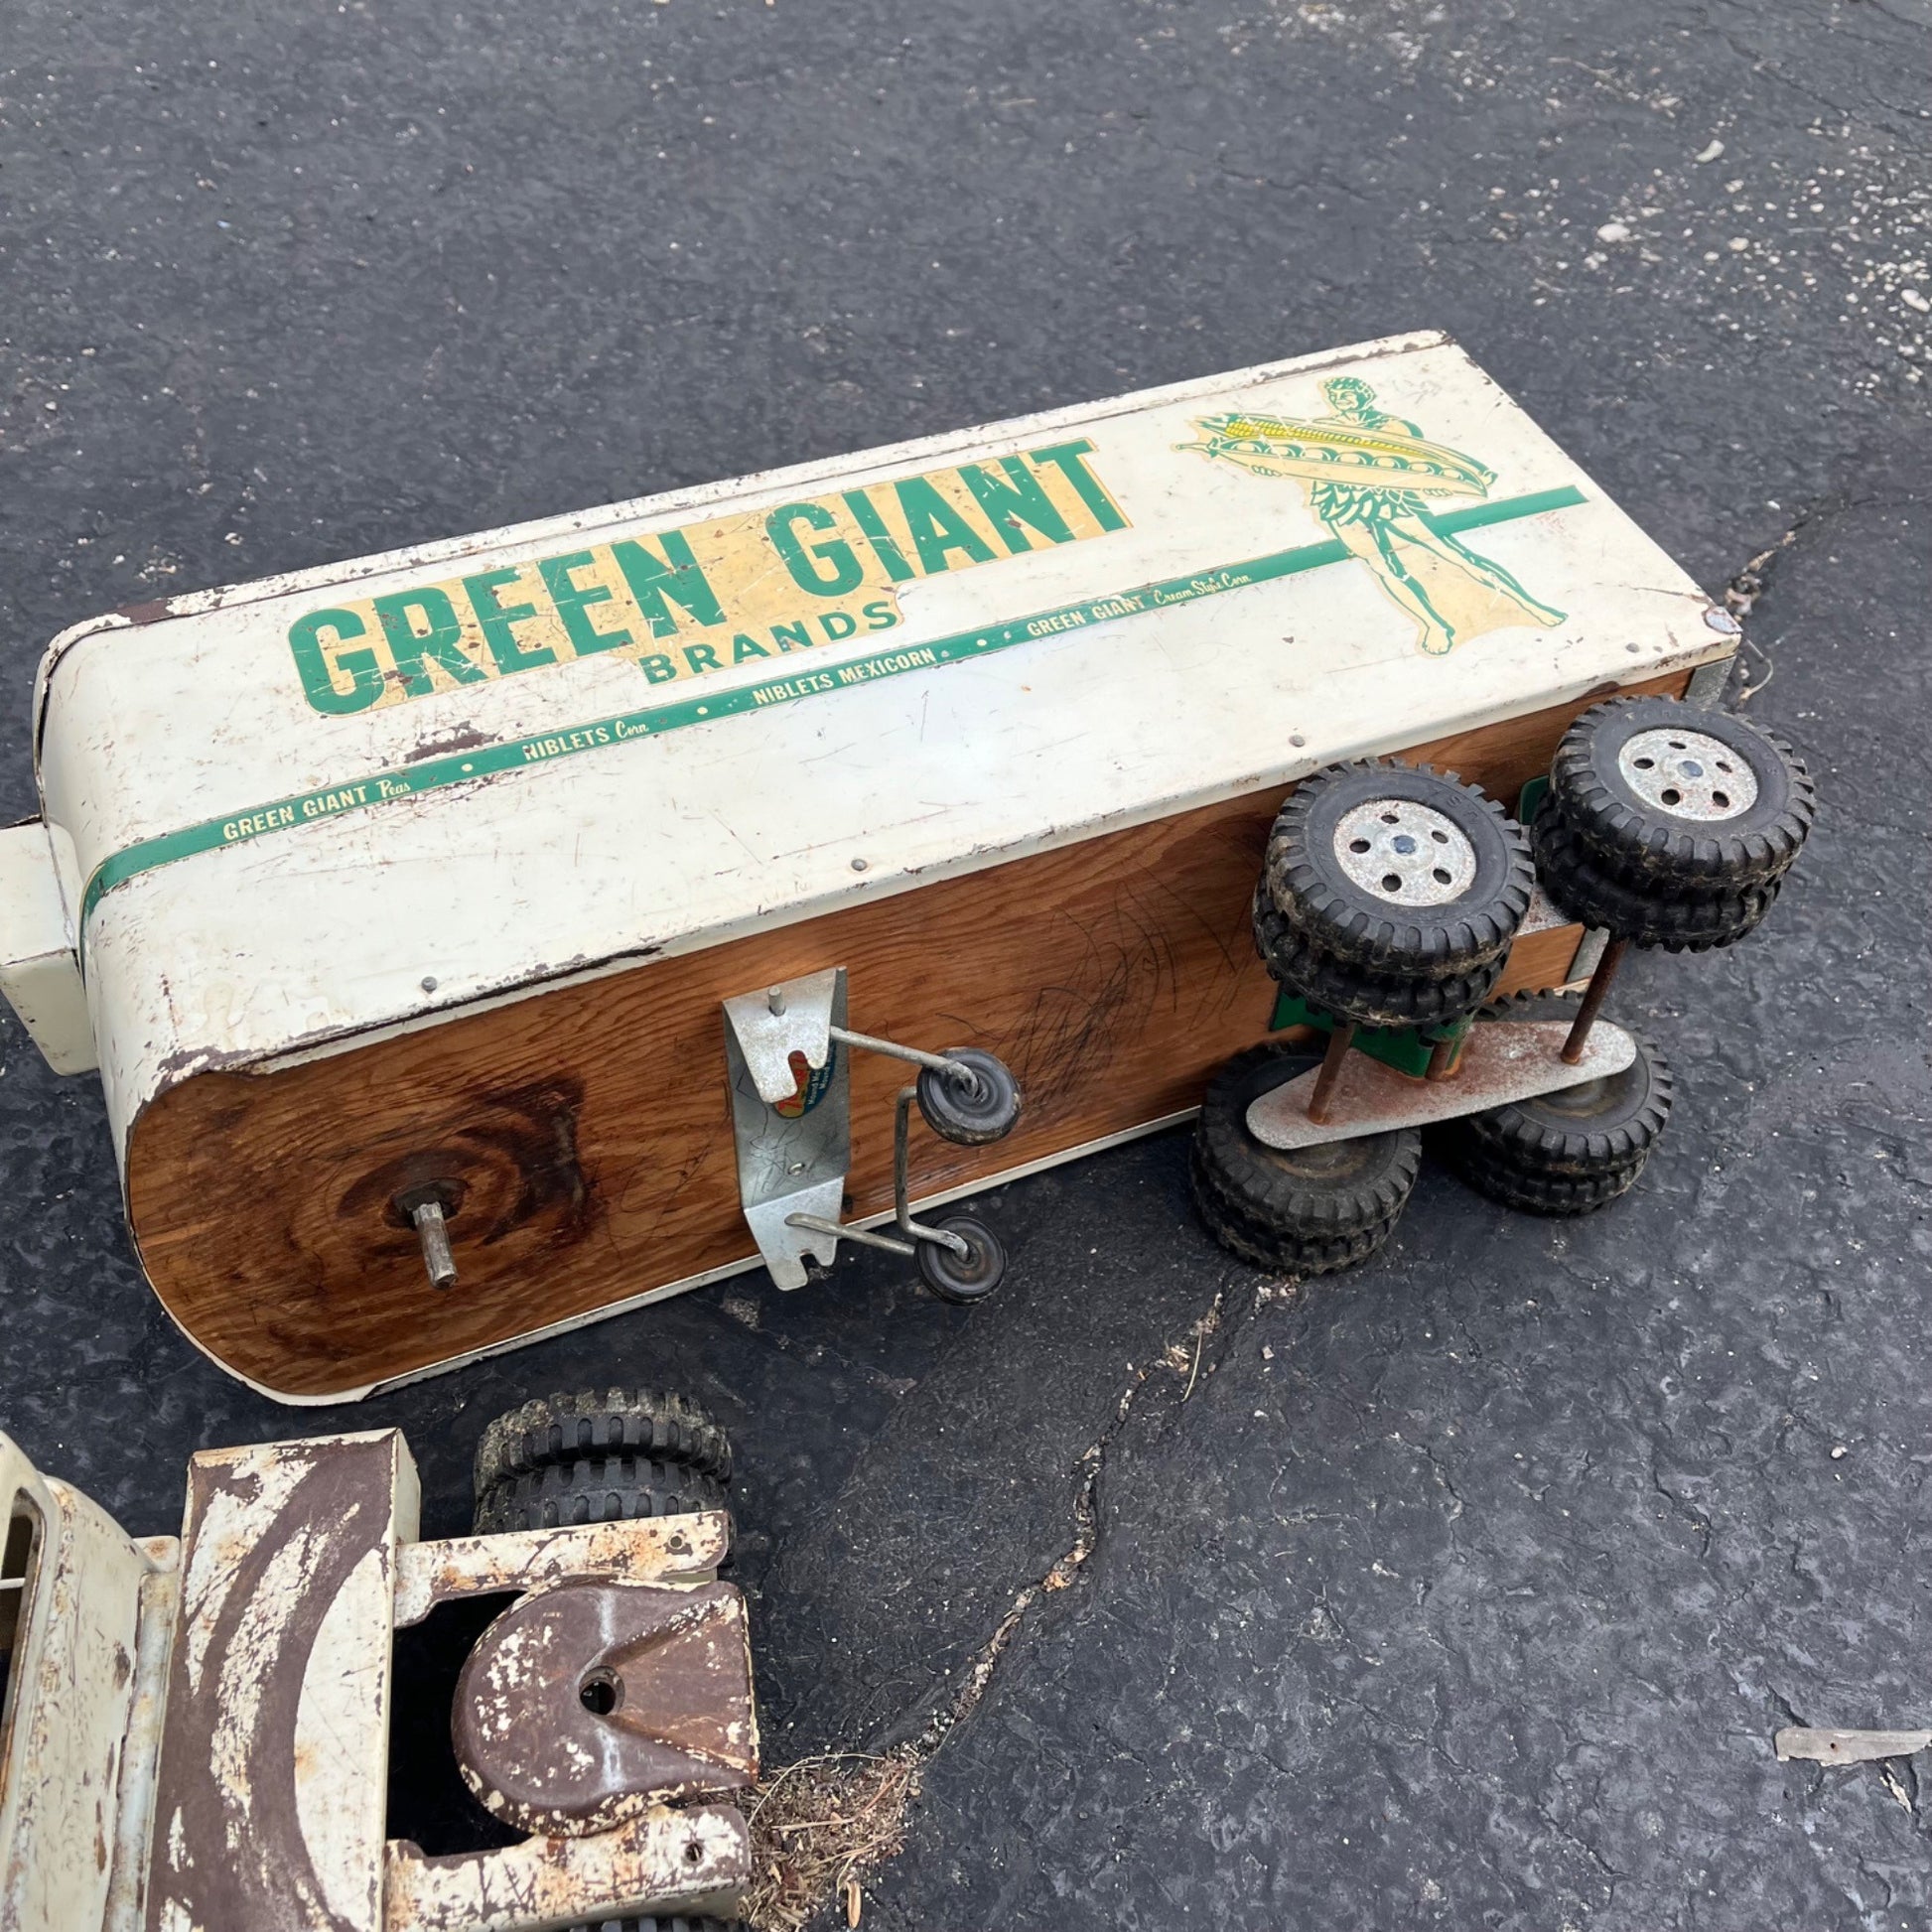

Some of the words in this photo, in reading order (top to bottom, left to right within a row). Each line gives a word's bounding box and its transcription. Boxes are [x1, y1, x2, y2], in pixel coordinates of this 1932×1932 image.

[223, 806, 295, 840] GREEN
[303, 786, 366, 817] GIANT
[375, 778, 411, 798] Peas
[522, 727, 610, 760] NIBLETS
[615, 721, 650, 739] Corn
[753, 673, 834, 705] NIBLETS
[838, 648, 937, 684] MEXICORN
[1027, 611, 1086, 636] GREEN
[1092, 596, 1145, 620] GIANT
[1154, 589, 1195, 605] Cream
[1190, 577, 1222, 595] Style
[1221, 572, 1252, 588] Corn
[288, 531, 726, 715] GREEN
[766, 440, 1128, 596] GIANT
[638, 602, 897, 684] BRANDS
